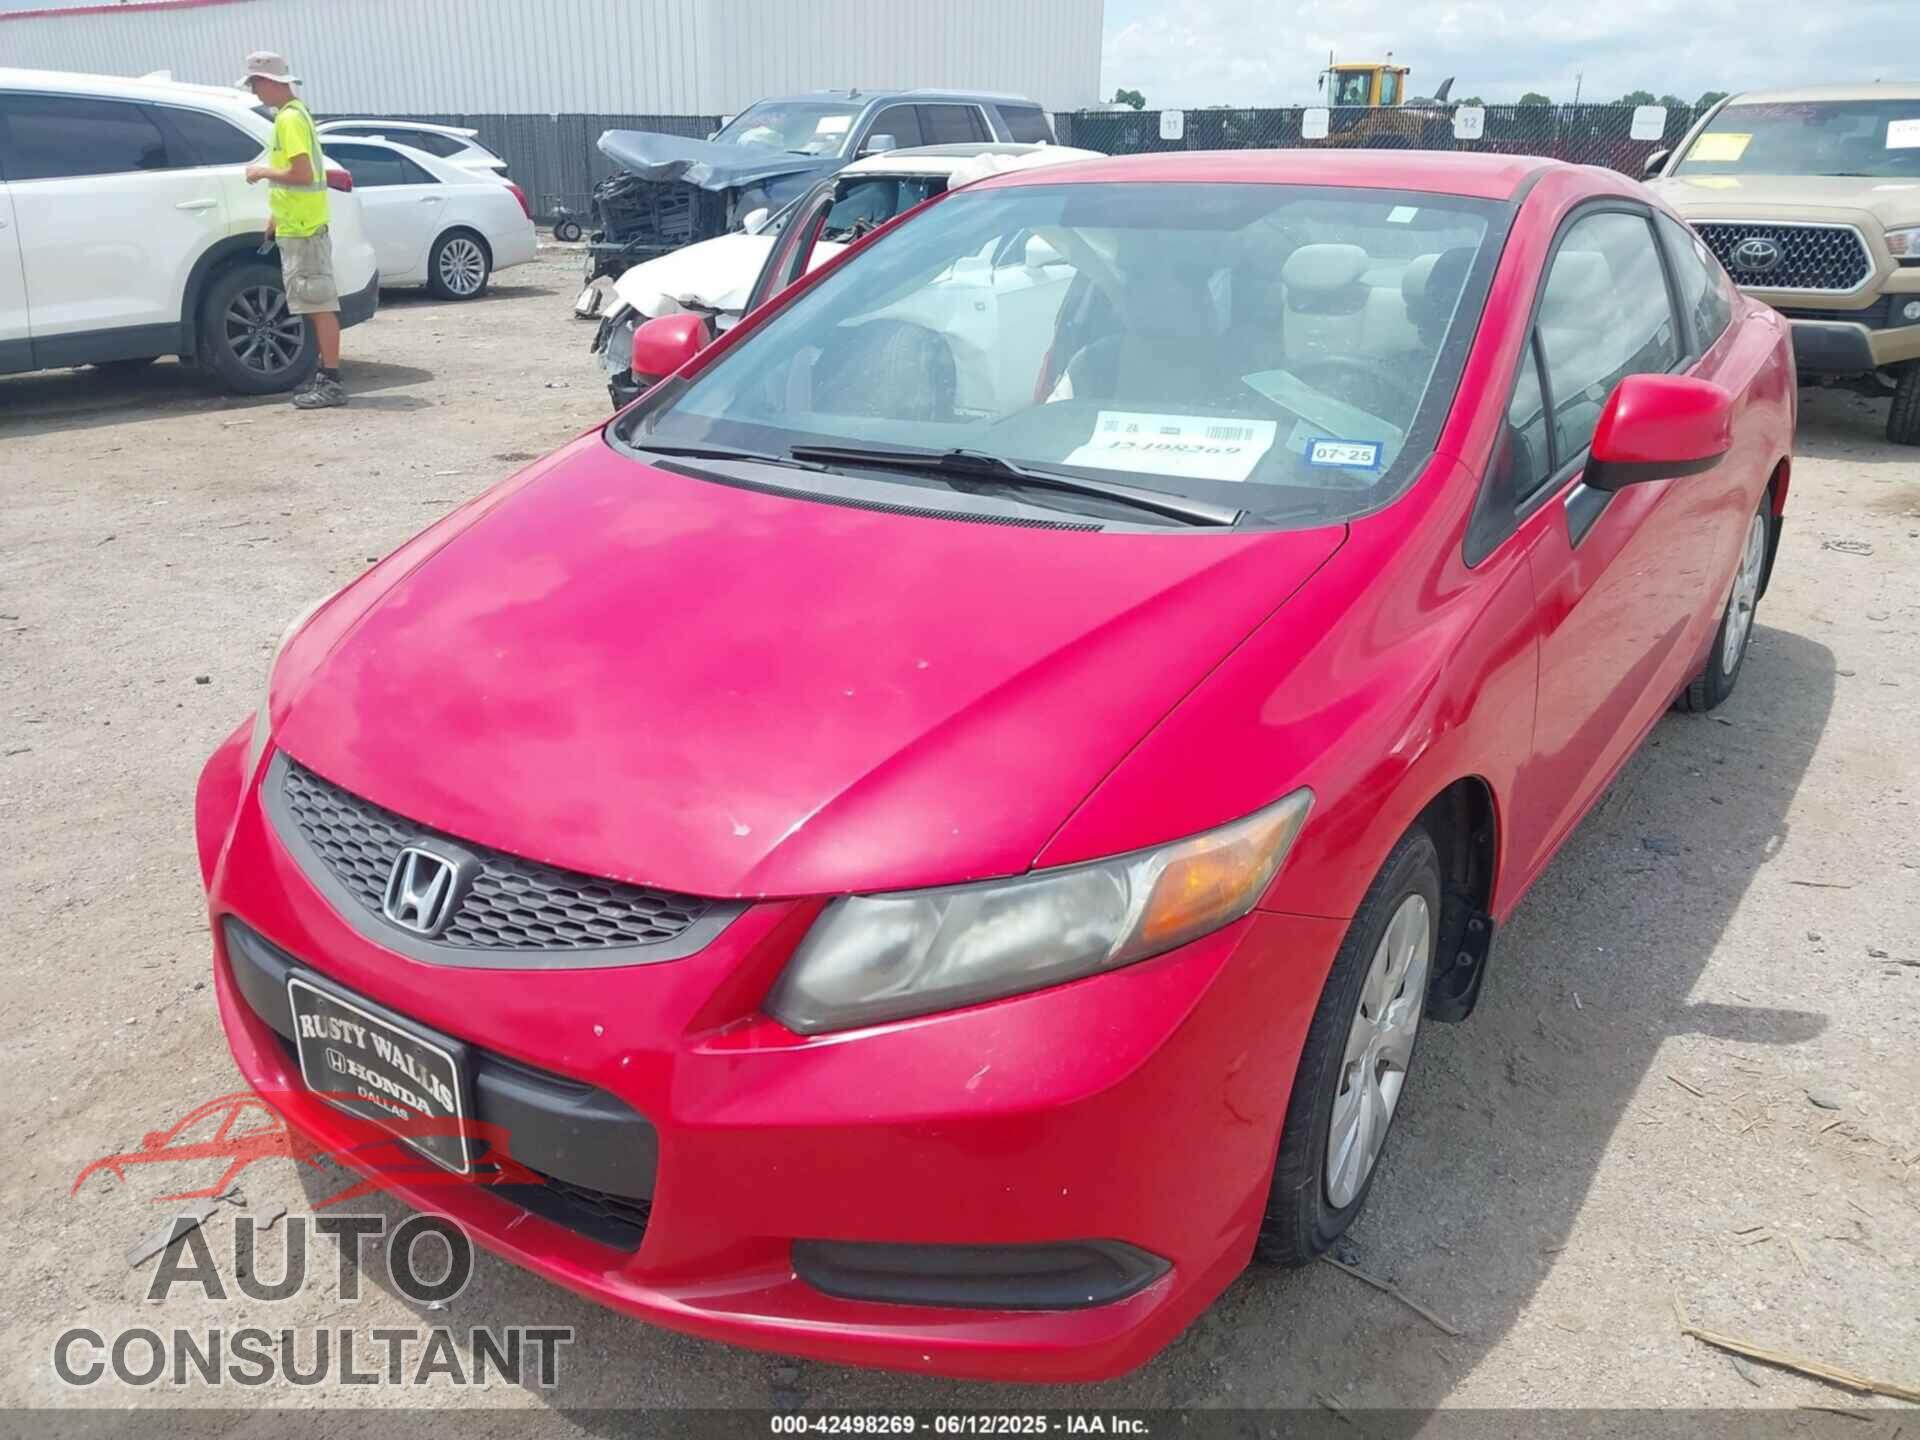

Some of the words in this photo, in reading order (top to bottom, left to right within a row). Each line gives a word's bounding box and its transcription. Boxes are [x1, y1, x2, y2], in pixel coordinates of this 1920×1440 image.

[1463, 117, 1477, 129] 12
[299, 1014, 367, 1050] RUSTY
[371, 1031, 455, 1114] WALLIS
[347, 1058, 435, 1119] HONDA
[357, 1086, 409, 1122] DALLAS
